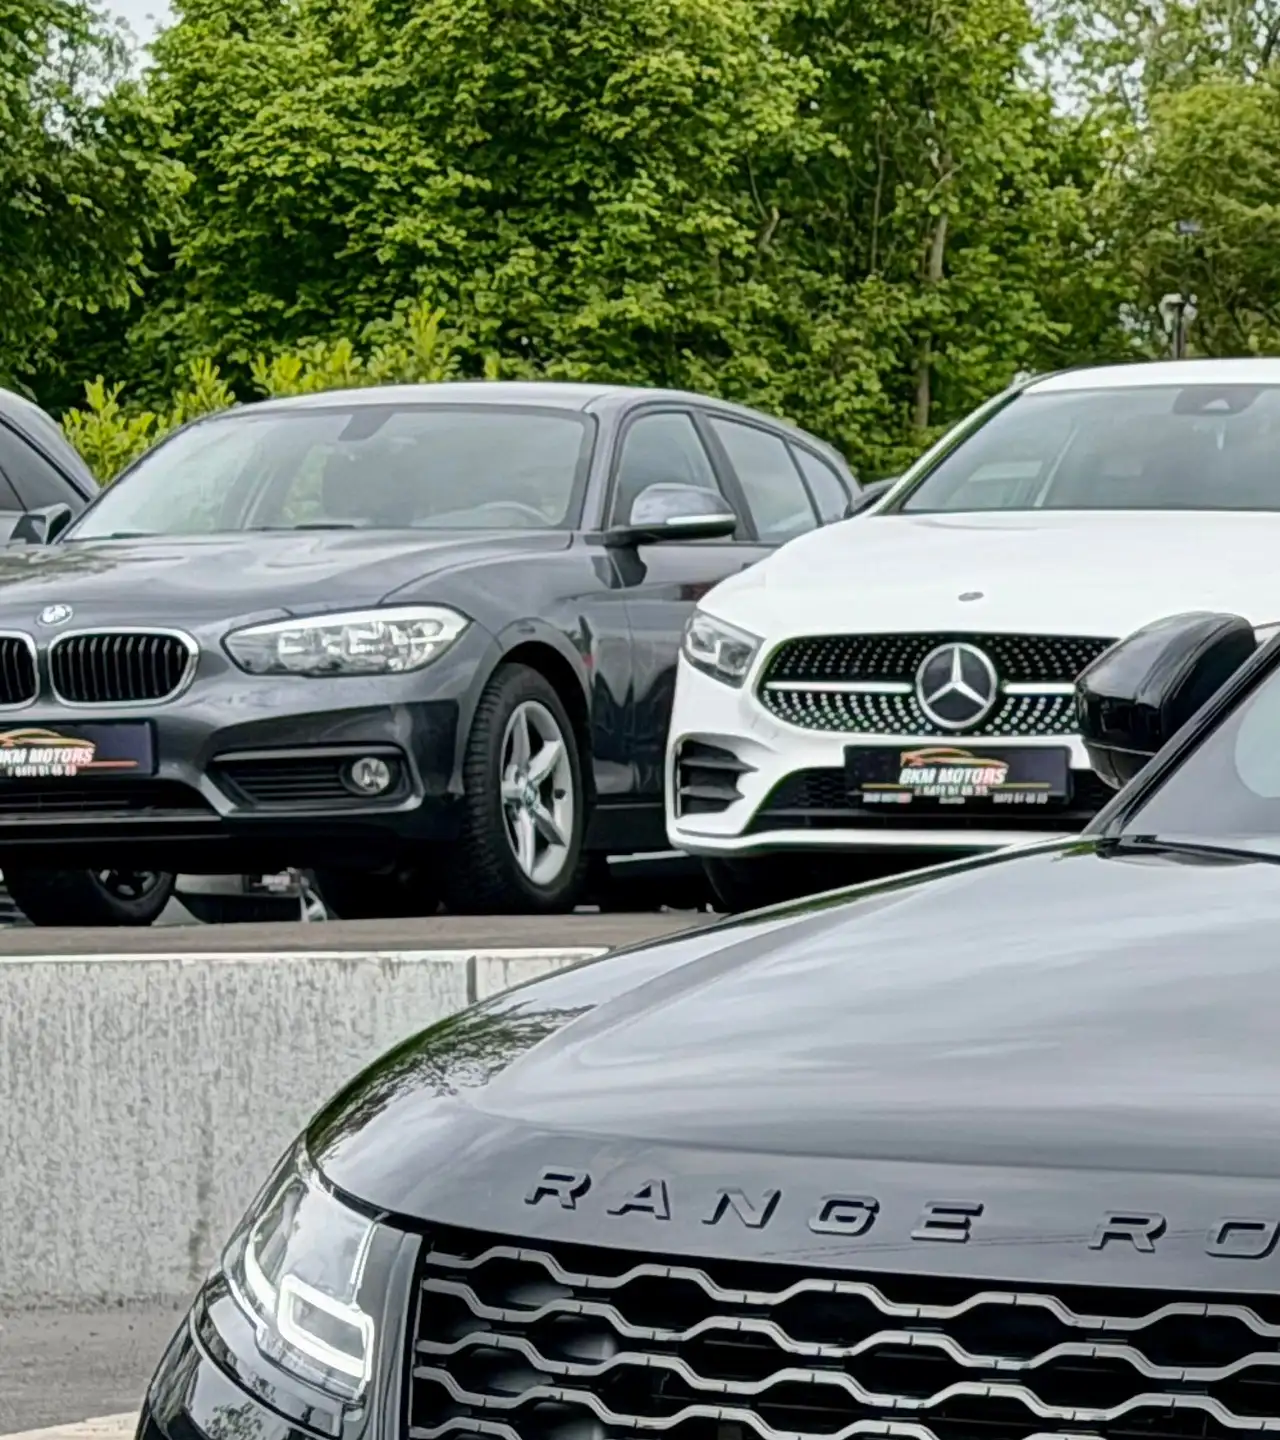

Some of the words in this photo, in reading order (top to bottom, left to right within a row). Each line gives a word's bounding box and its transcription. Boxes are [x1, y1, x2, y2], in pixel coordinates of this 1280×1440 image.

[29, 748, 95, 764] MOTORS
[899, 768, 936, 784] BKM
[938, 768, 1008, 785] MOTORS
[524, 1164, 984, 1243] RANGE
